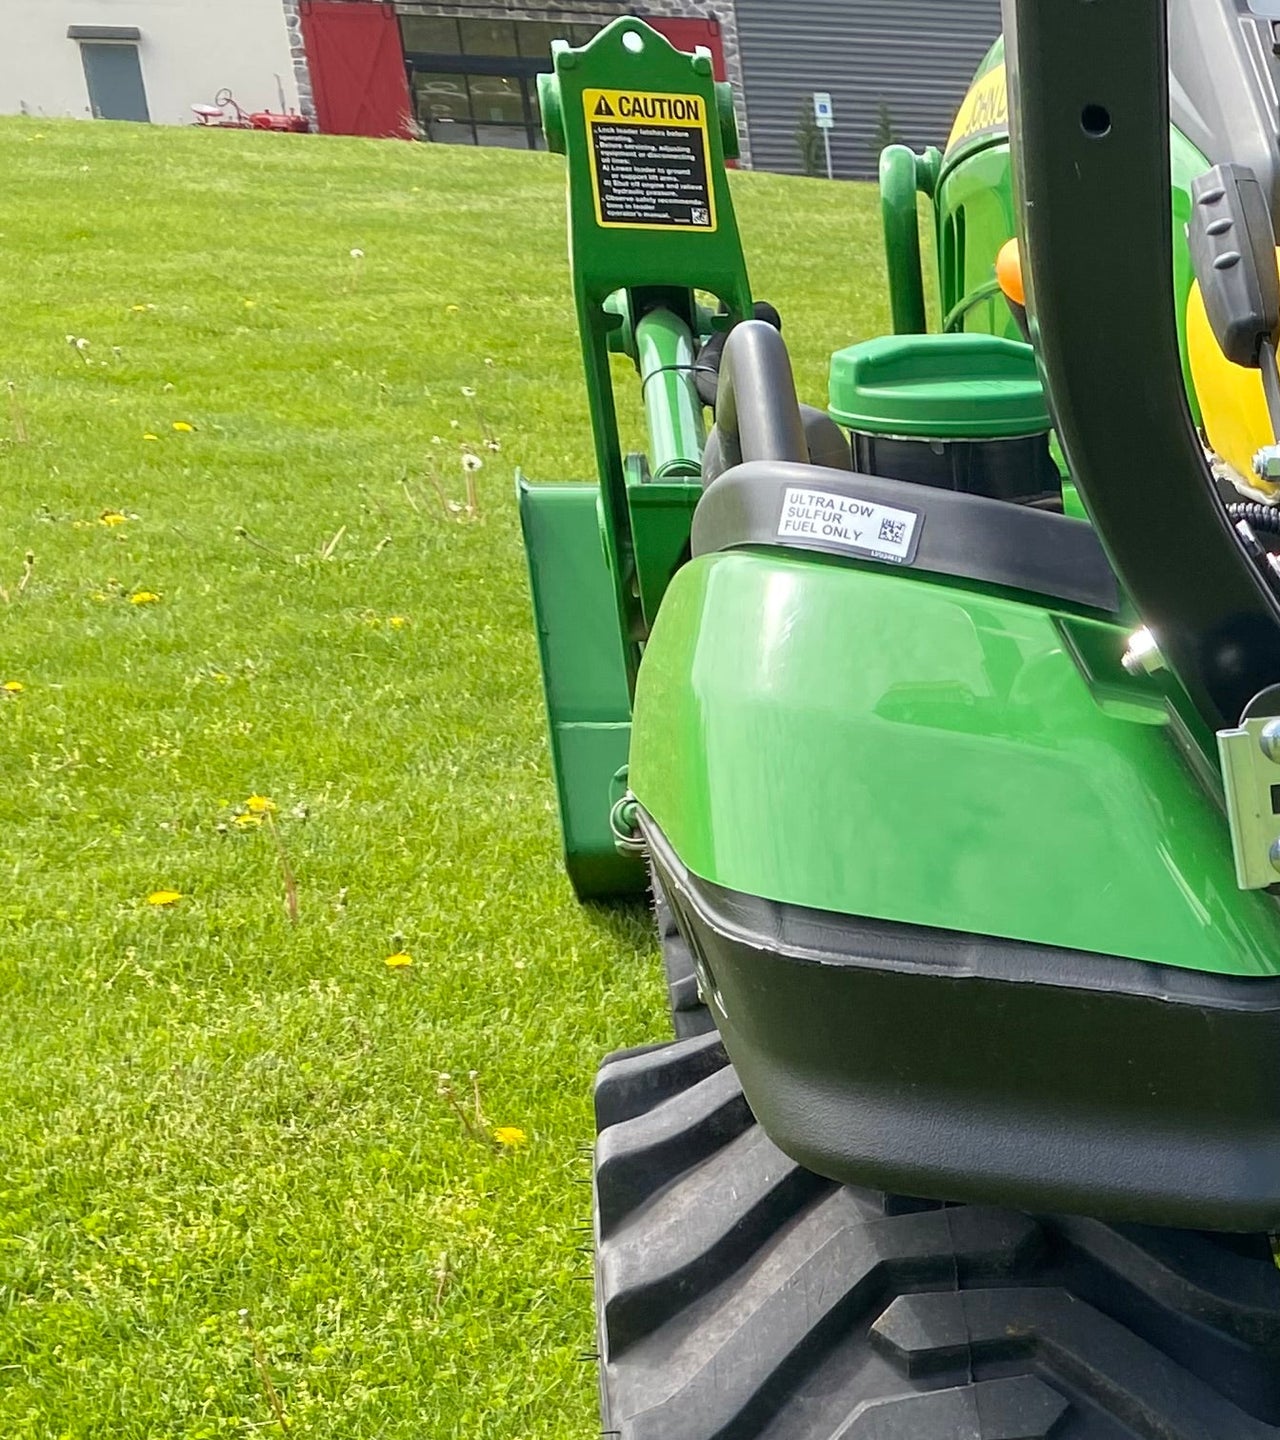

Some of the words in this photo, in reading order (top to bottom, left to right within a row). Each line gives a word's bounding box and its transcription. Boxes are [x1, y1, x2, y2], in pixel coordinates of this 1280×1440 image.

[618, 96, 700, 121] CAUTION
[786, 506, 843, 524] SULFUR
[789, 493, 835, 510] ULTRA
[839, 501, 875, 518] LOW
[784, 519, 817, 533] FUEL
[822, 524, 863, 541] ONLY
